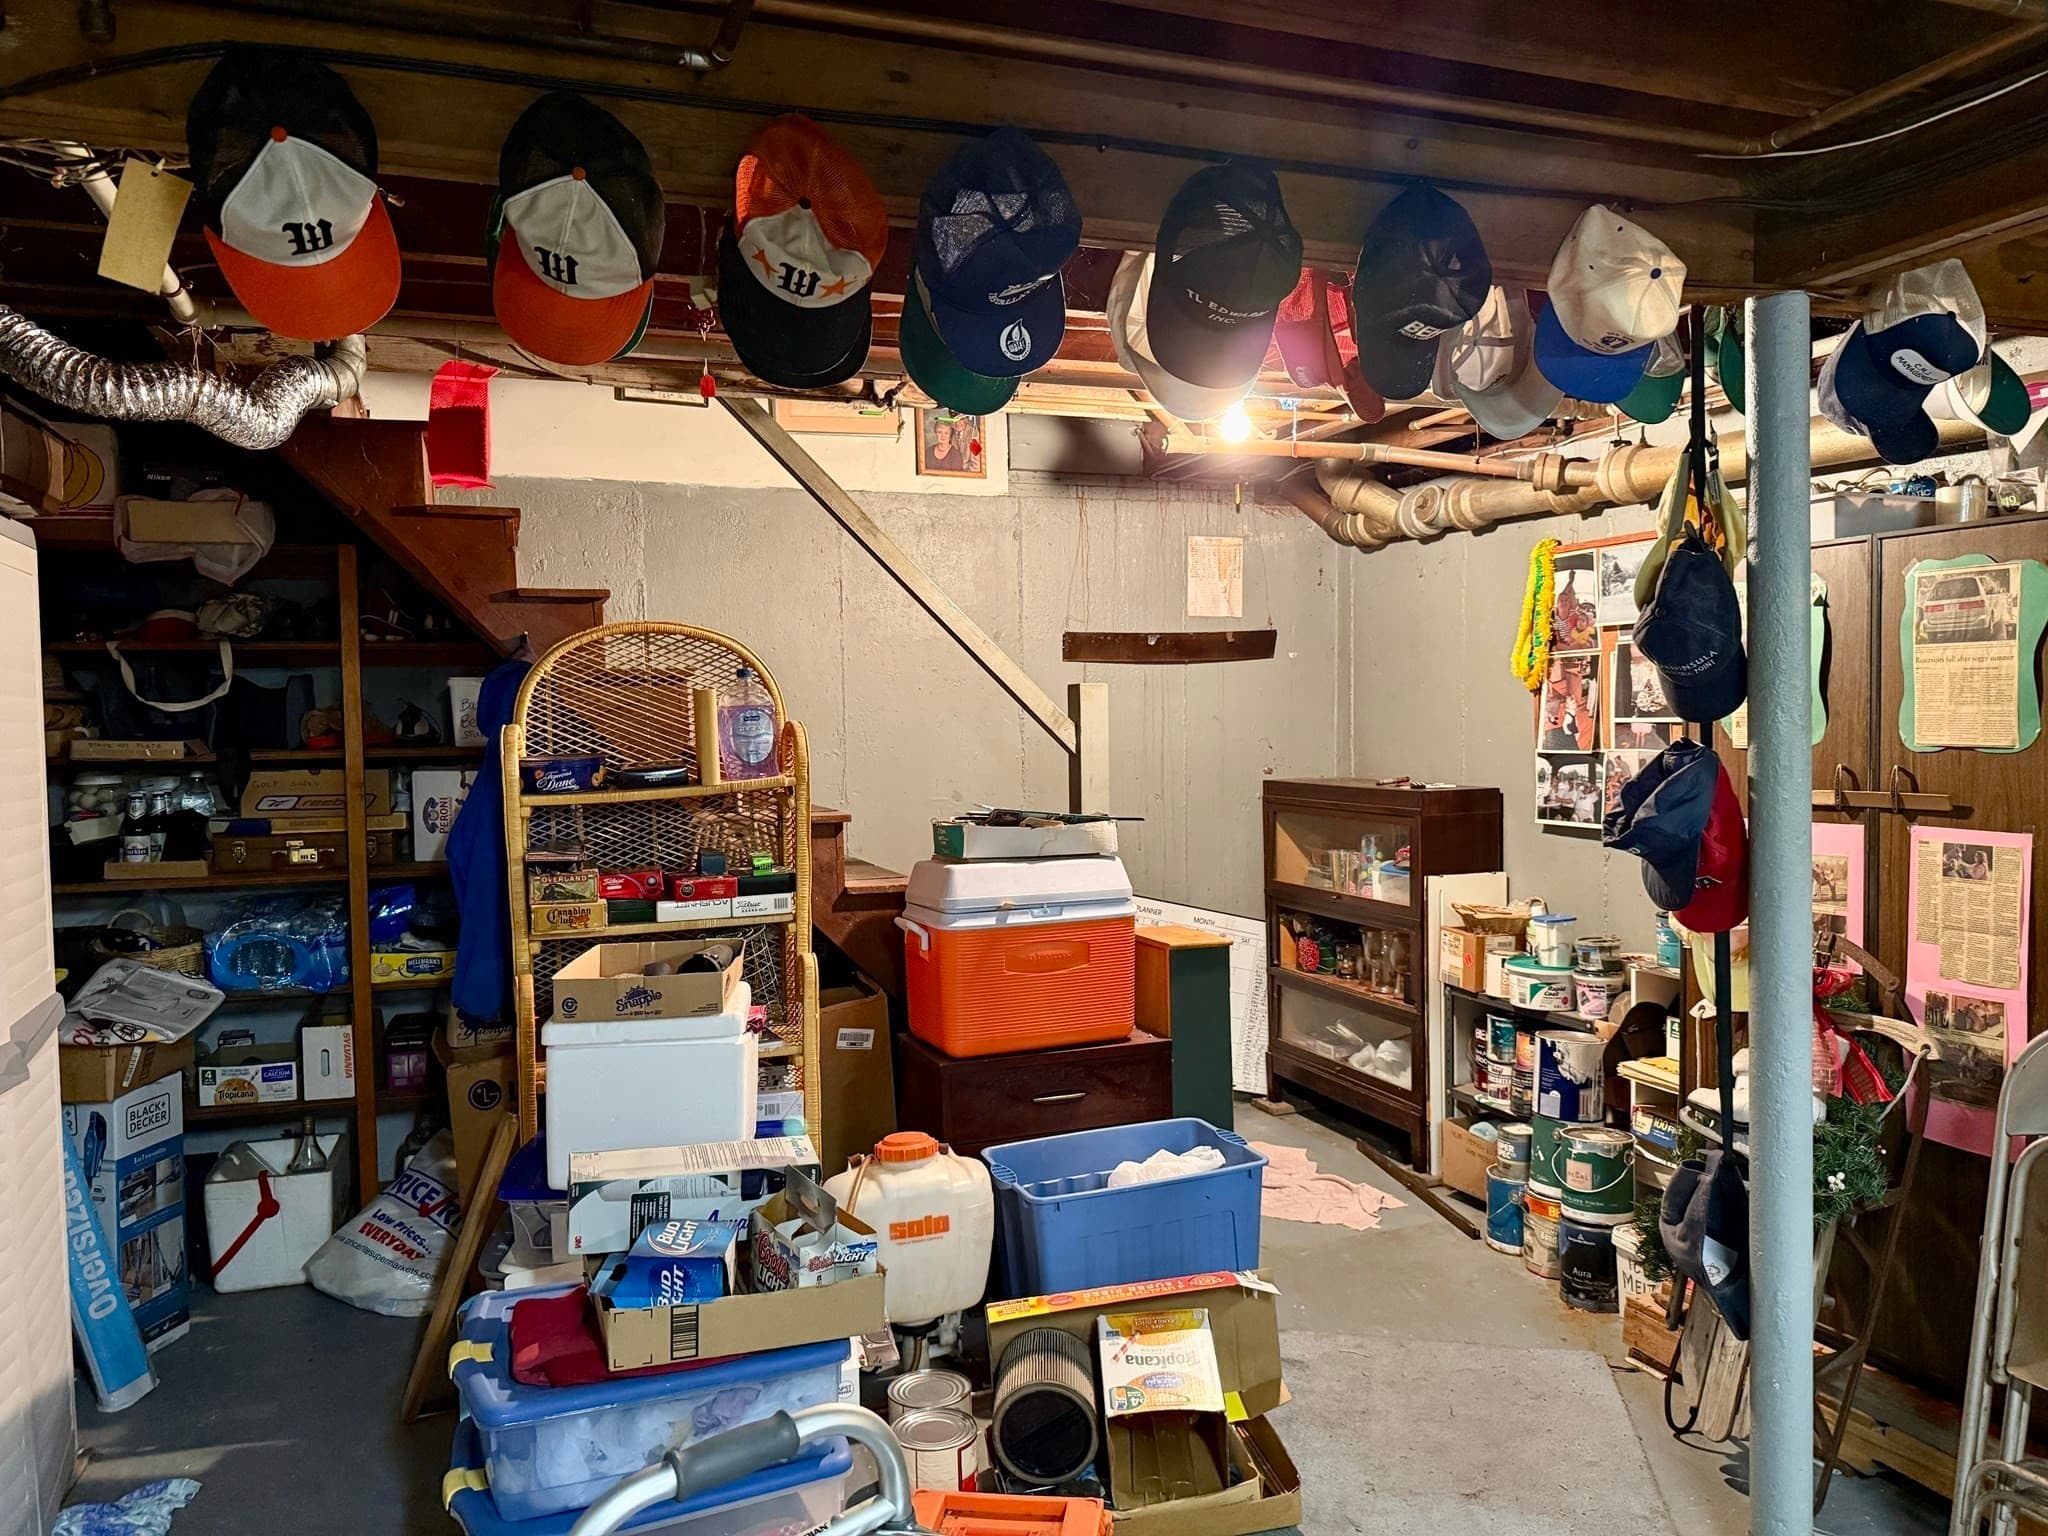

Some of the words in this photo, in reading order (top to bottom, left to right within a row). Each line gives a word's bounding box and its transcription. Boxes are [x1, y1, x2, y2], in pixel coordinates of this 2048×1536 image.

[1186, 287, 1204, 305] TL
[146, 473, 172, 482] Nikon
[438, 796, 449, 834] PERONI
[540, 875, 589, 884] OVERLAND
[1193, 916, 1216, 926] MONTH
[615, 989, 663, 1012] Snapple
[343, 1032, 353, 1079] SYLVANIA
[217, 1088, 254, 1100] Tropicana
[129, 1100, 167, 1121] BLACK+
[129, 1111, 167, 1133] DECKER
[372, 1208, 395, 1226] Low
[657, 1221, 682, 1245] BUD
[671, 1220, 699, 1252] LIGHT
[888, 1214, 951, 1241] solo
[358, 1221, 426, 1261] EVERYDAY
[834, 1248, 868, 1264] LIGHT
[1572, 1266, 1593, 1279] Aura
[1125, 1349, 1200, 1369] Tropicana
